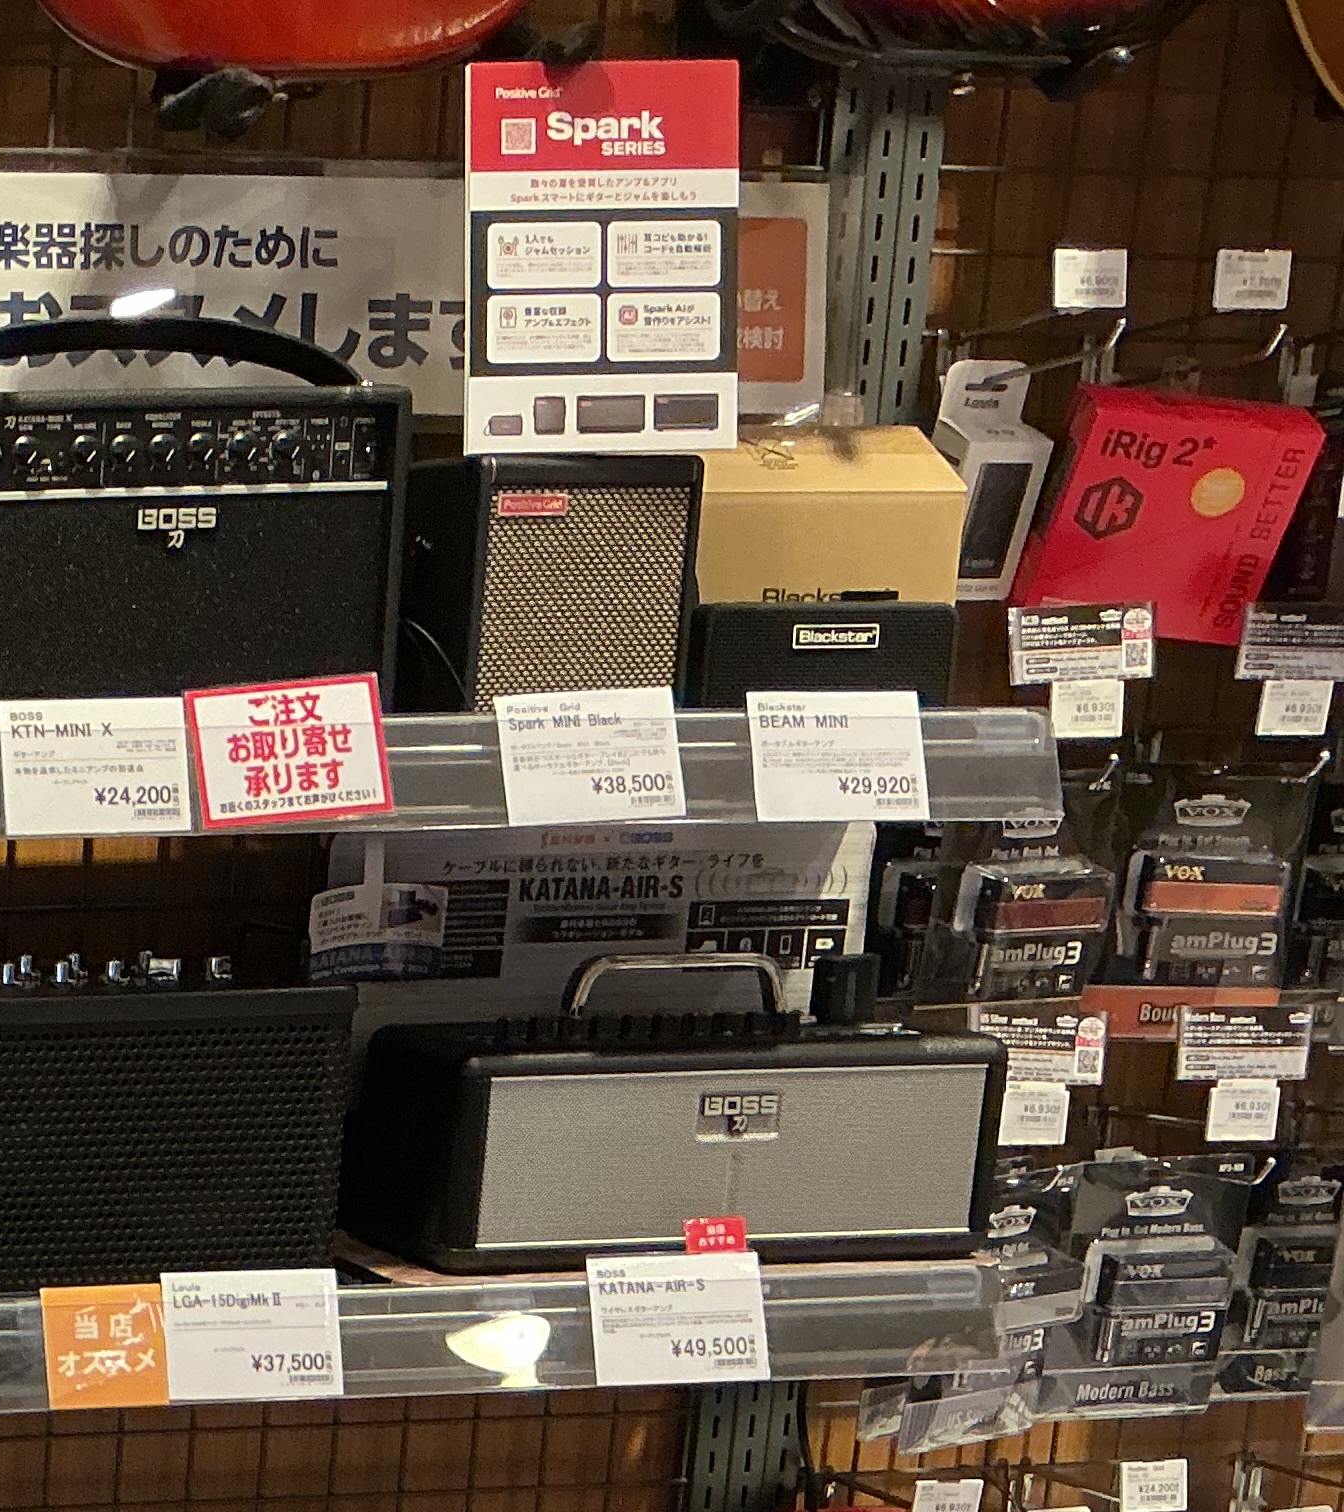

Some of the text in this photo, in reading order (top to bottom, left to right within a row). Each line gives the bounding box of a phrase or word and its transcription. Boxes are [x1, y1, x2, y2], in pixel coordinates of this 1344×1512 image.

[547, 110, 664, 145] Spark
[602, 141, 665, 155] SERIES
[511, 194, 539, 202] Spark
[525, 246, 590, 255] ジャムセッション
[1100, 430, 1201, 469] iRig 2
[138, 508, 216, 530] BOSS
[1213, 448, 1305, 630] SOUND BETTER
[800, 630, 878, 644] Blackstar
[10, 712, 43, 721] BOSS
[248, 692, 323, 726] ご注文
[11, 722, 113, 738] KTN-MINI X
[508, 712, 622, 731] Spark MINI Black
[760, 714, 848, 729] BEAM MINI
[227, 725, 352, 763] お取り寄せ
[245, 759, 344, 798] 承ります
[591, 774, 666, 795] ¥38,500
[839, 776, 910, 795] ¥29,920
[94, 786, 171, 807] ¥24,200
[1184, 806, 1236, 818] VOX
[1165, 865, 1205, 881] VOX
[519, 876, 684, 900] KATANA-AIR-S
[1012, 884, 1045, 899] VOX
[993, 941, 1083, 964] amPlug3
[1171, 933, 1278, 955] amPlug3
[704, 1097, 777, 1115] BOSS
[1134, 1196, 1183, 1208] VOX
[597, 1269, 625, 1278] BOSS
[1126, 1264, 1164, 1278] VOX
[599, 1279, 705, 1295] KATANA-AIR-S
[74, 1307, 134, 1341] 当店
[1121, 1312, 1215, 1332] amPlug3
[671, 1337, 747, 1358] ¥49,500
[58, 1348, 155, 1376] オススメ
[252, 1354, 324, 1372] ¥37,500
[1077, 1382, 1173, 1401] Modern Bass
